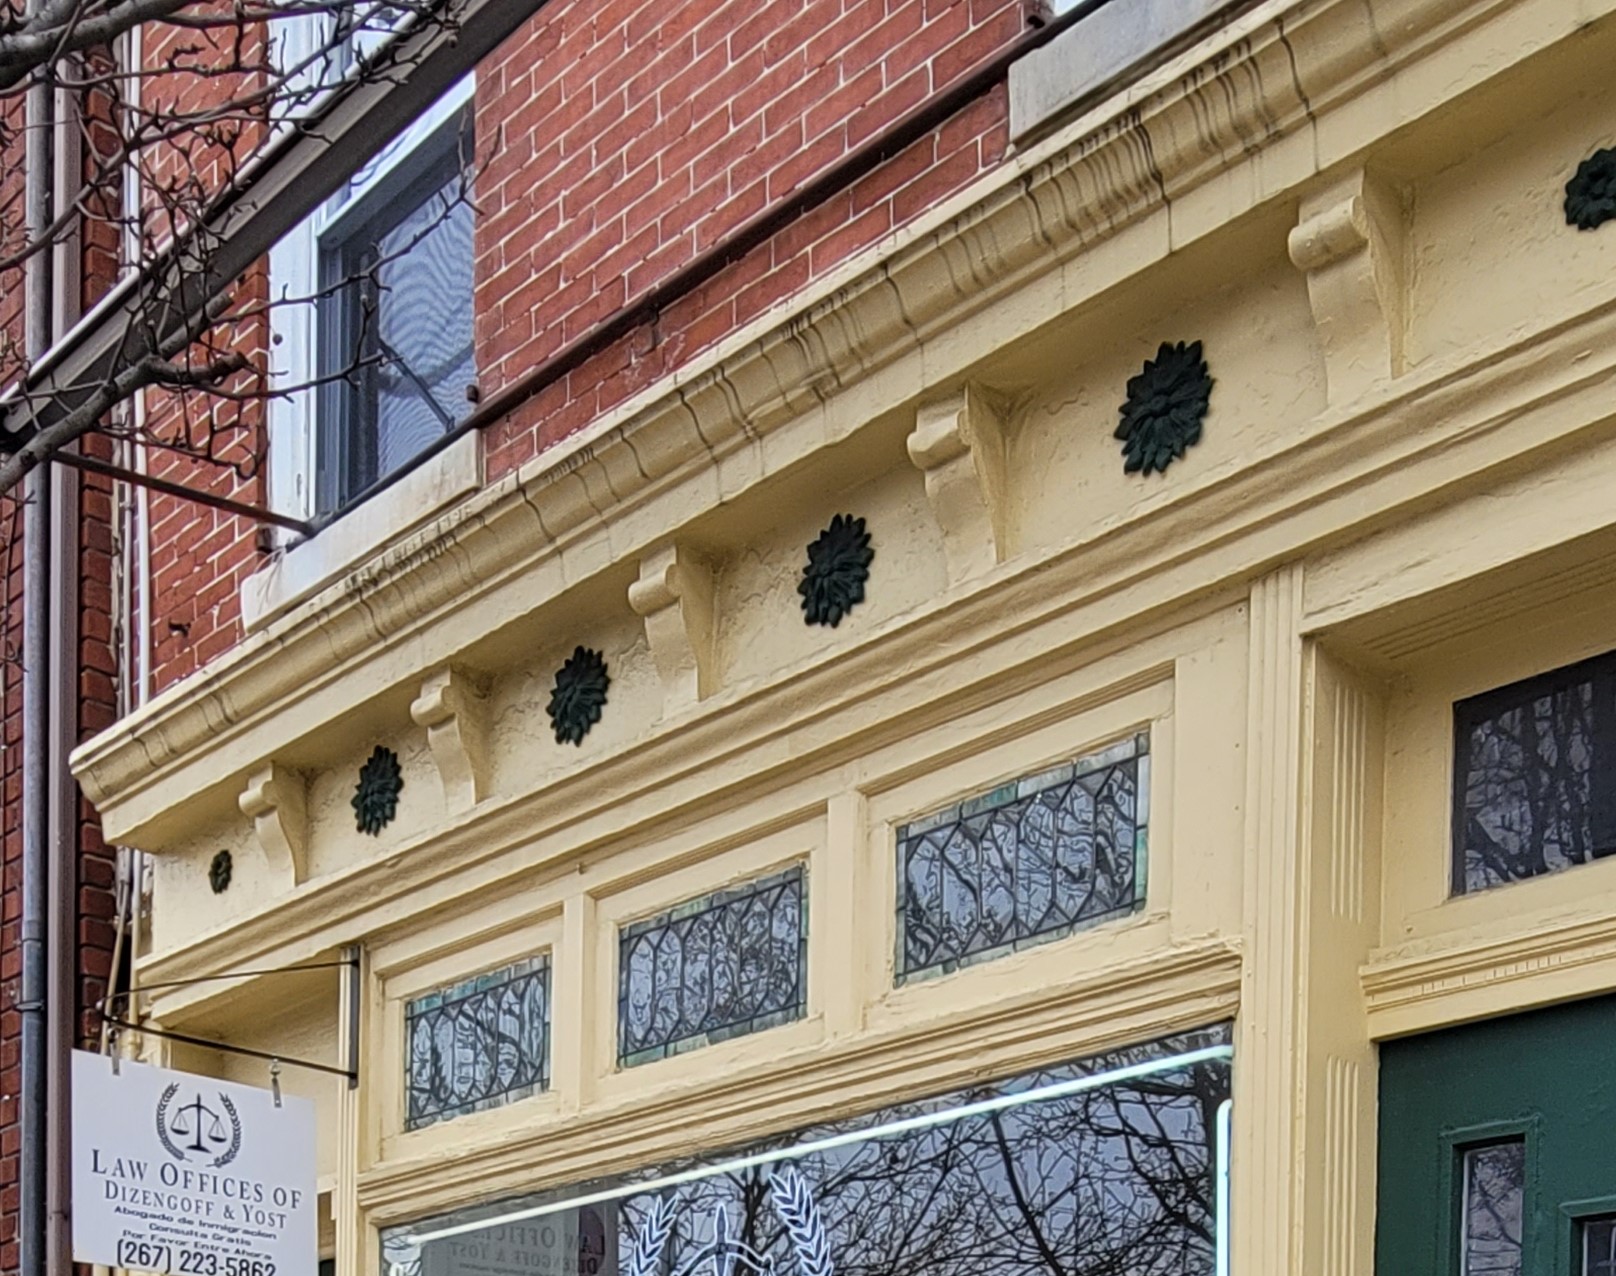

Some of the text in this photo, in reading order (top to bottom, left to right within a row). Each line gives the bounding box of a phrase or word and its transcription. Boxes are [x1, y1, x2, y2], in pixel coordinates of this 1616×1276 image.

[92, 1149, 302, 1210] LAW OFFICES OF
[104, 1180, 287, 1229] DIZENGOFF & YOST
[114, 1205, 174, 1223] Abogado
[177, 1216, 195, 1226] de
[122, 1229, 273, 1261] Por Favor Entre Ahora
[148, 1222, 252, 1247] Consulta Gratis
[117, 1238, 172, 1274] (267)
